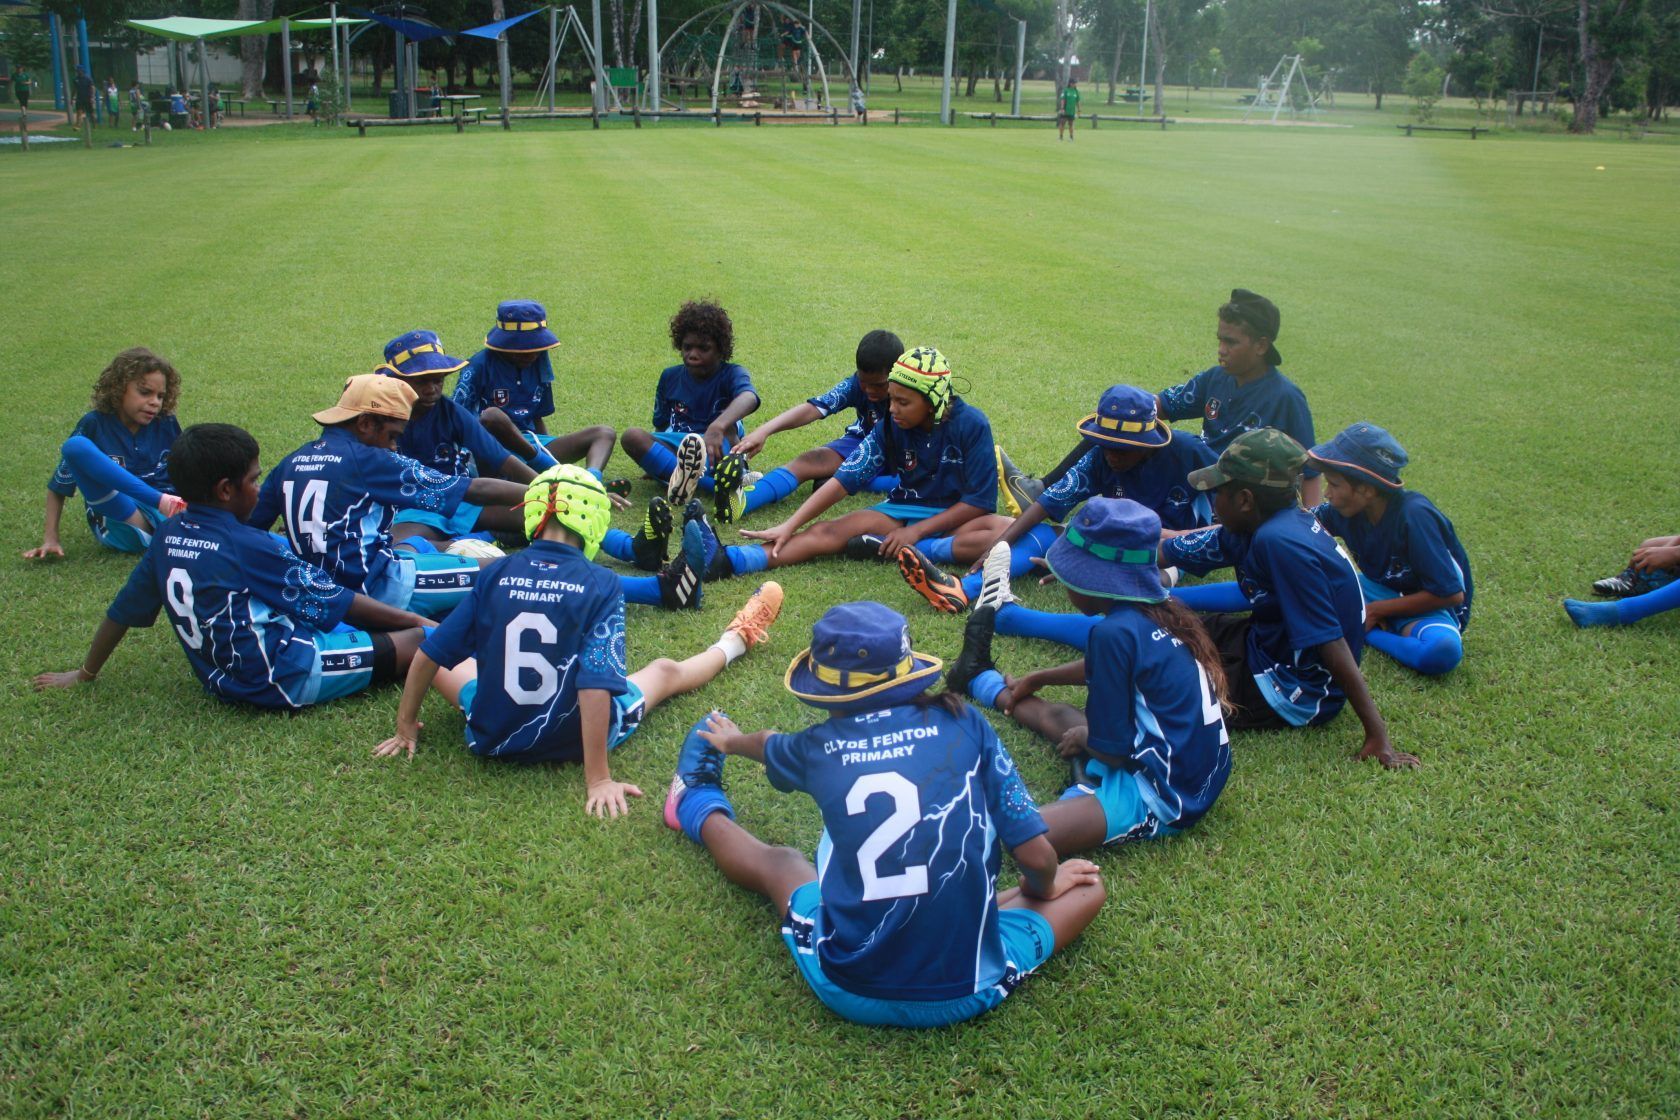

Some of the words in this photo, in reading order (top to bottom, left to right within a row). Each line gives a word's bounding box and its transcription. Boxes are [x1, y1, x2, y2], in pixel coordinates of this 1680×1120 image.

[294, 464, 325, 472] PRIMARY
[310, 454, 342, 463] FENTON
[282, 479, 328, 554] 14
[167, 547, 201, 560] PRIMARY
[182, 537, 220, 551] FENTON
[498, 577, 533, 588] CLYDE
[536, 580, 585, 593] FENTON
[509, 589, 564, 603] PRIMARY
[166, 568, 203, 649] 9
[503, 611, 558, 706] 6
[823, 739, 869, 754] CLYDE
[872, 726, 939, 749] FENTON
[841, 744, 916, 766] PRIMARY
[845, 771, 929, 902] 2
